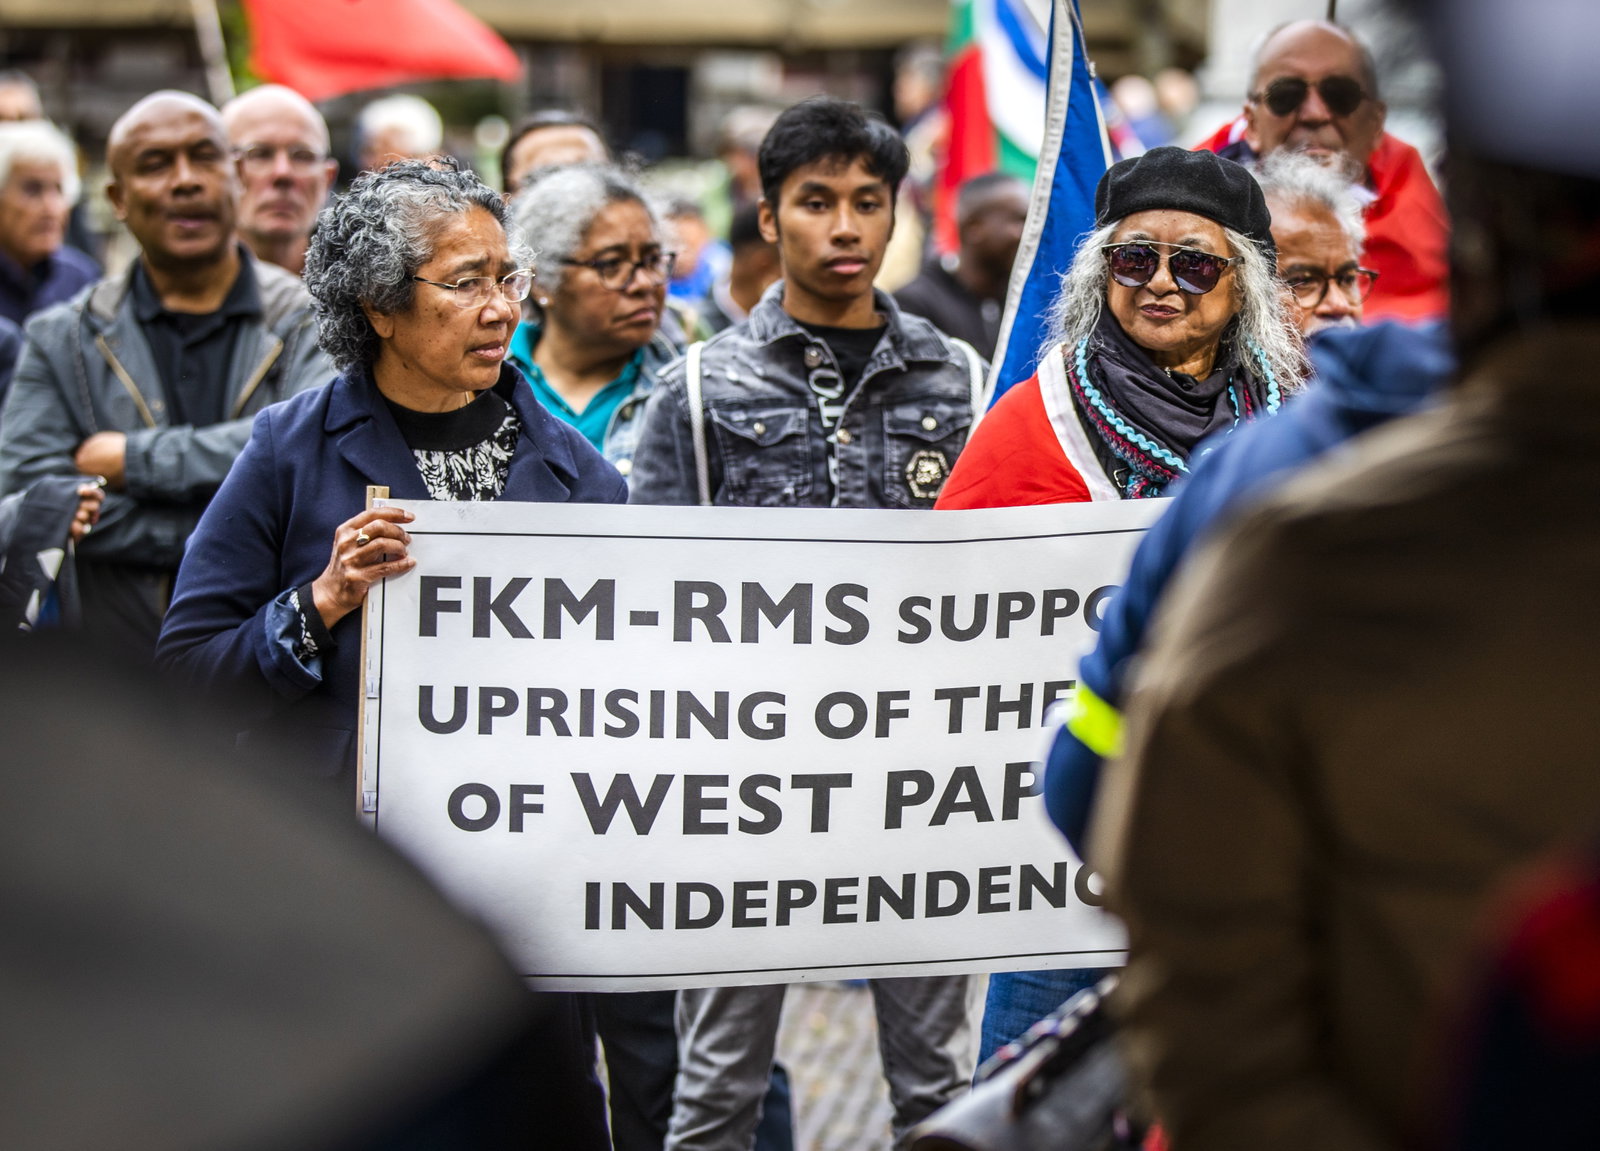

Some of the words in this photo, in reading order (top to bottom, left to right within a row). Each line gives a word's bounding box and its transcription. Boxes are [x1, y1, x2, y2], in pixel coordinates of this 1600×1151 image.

[419, 576, 870, 646] FKM-RMS
[418, 686, 786, 741] UPRISING
[815, 690, 910, 740] OF
[447, 783, 545, 832] OF
[570, 772, 853, 835] WEST
[884, 761, 1045, 830] PAP
